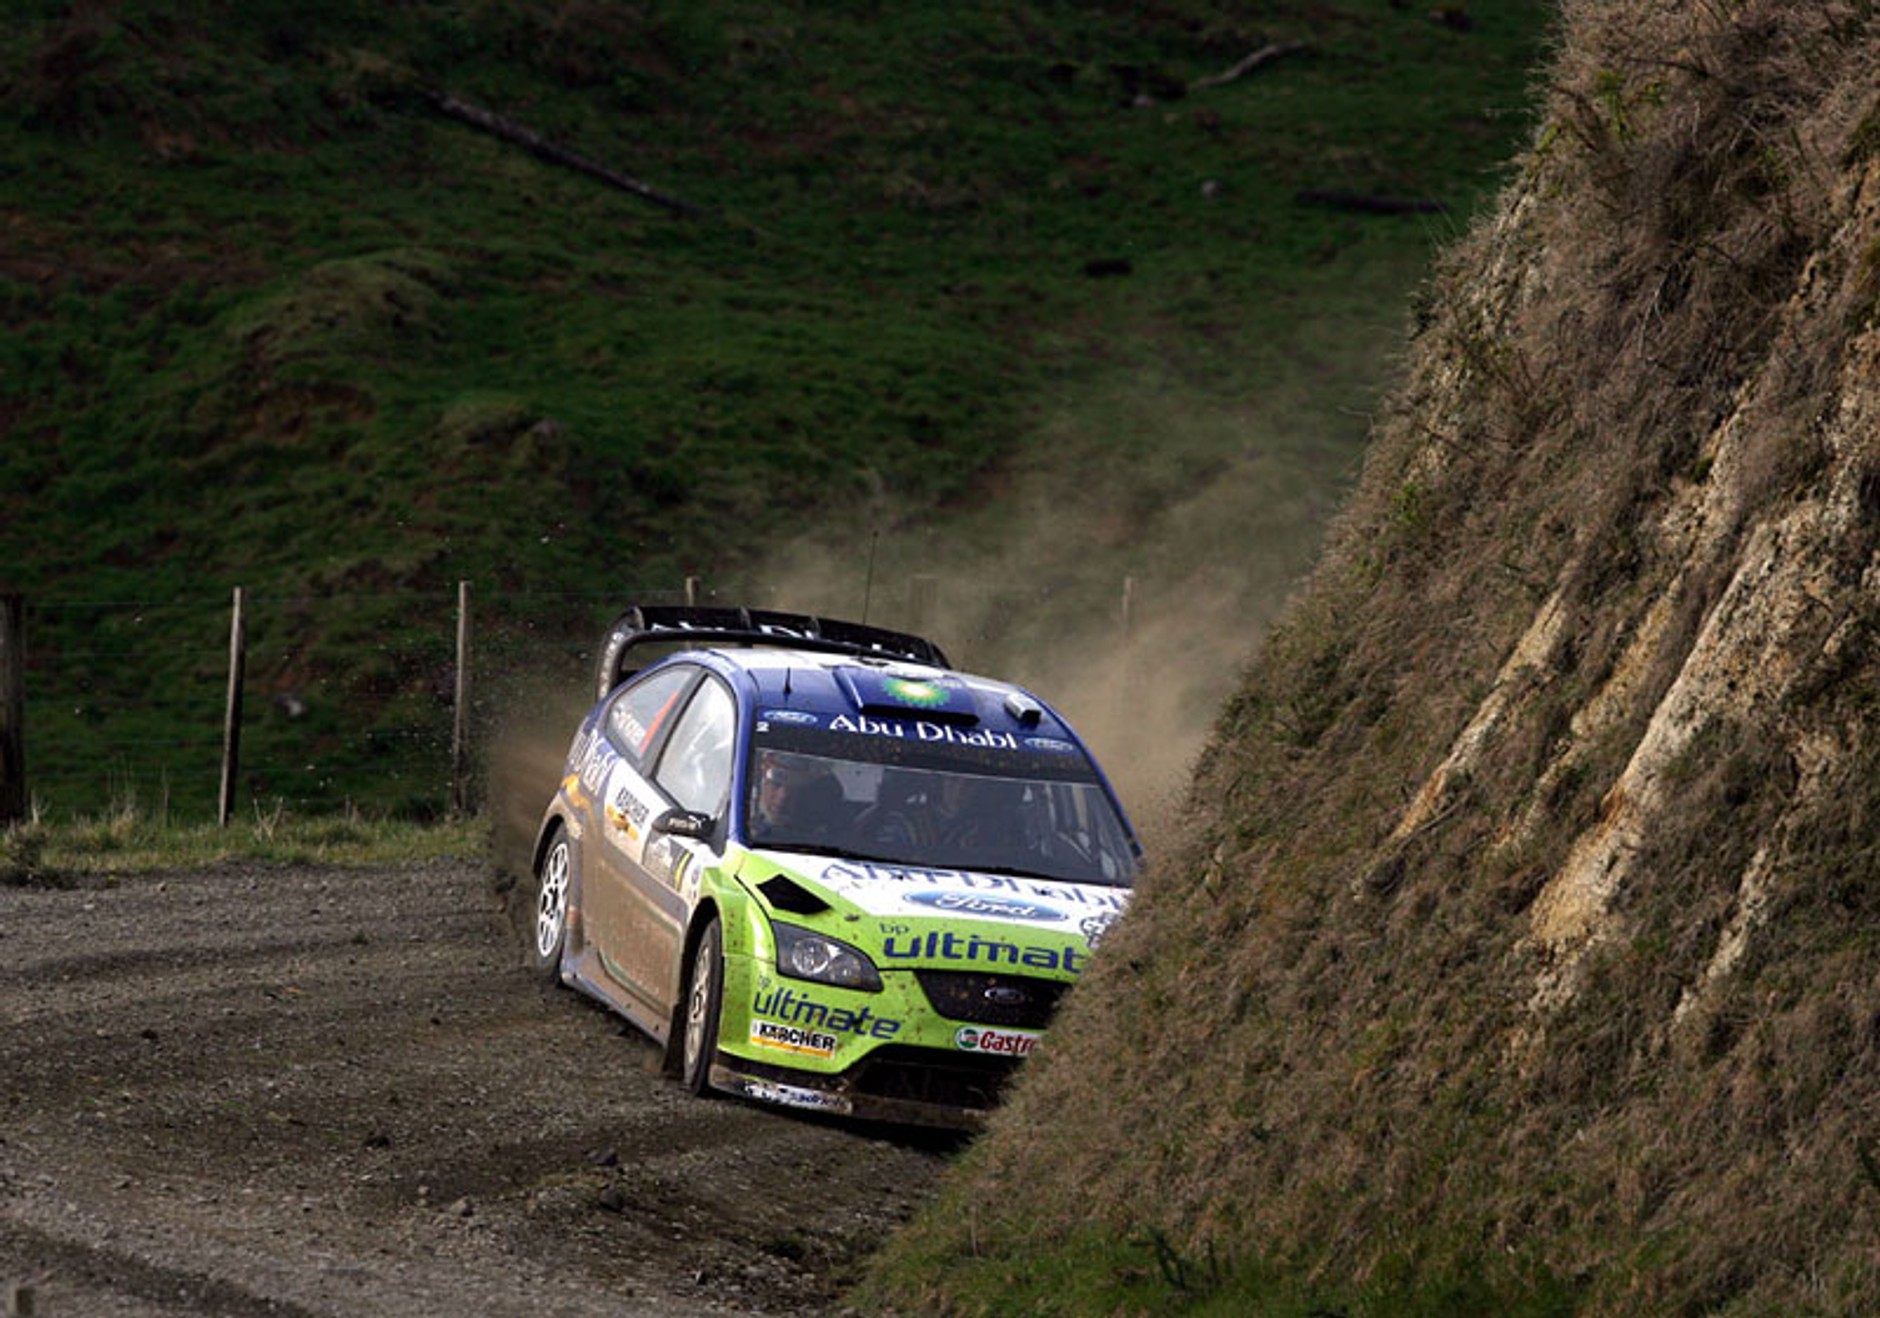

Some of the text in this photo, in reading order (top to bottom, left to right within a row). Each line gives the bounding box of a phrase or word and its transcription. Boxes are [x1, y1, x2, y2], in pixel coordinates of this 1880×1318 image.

[829, 714, 1019, 750] Abu Dhabi
[936, 891, 1038, 917] Ford
[879, 922, 910, 936] bp
[883, 931, 1088, 974] ultimat
[753, 987, 900, 1040] ultimate
[980, 1030, 1040, 1054] Castr
